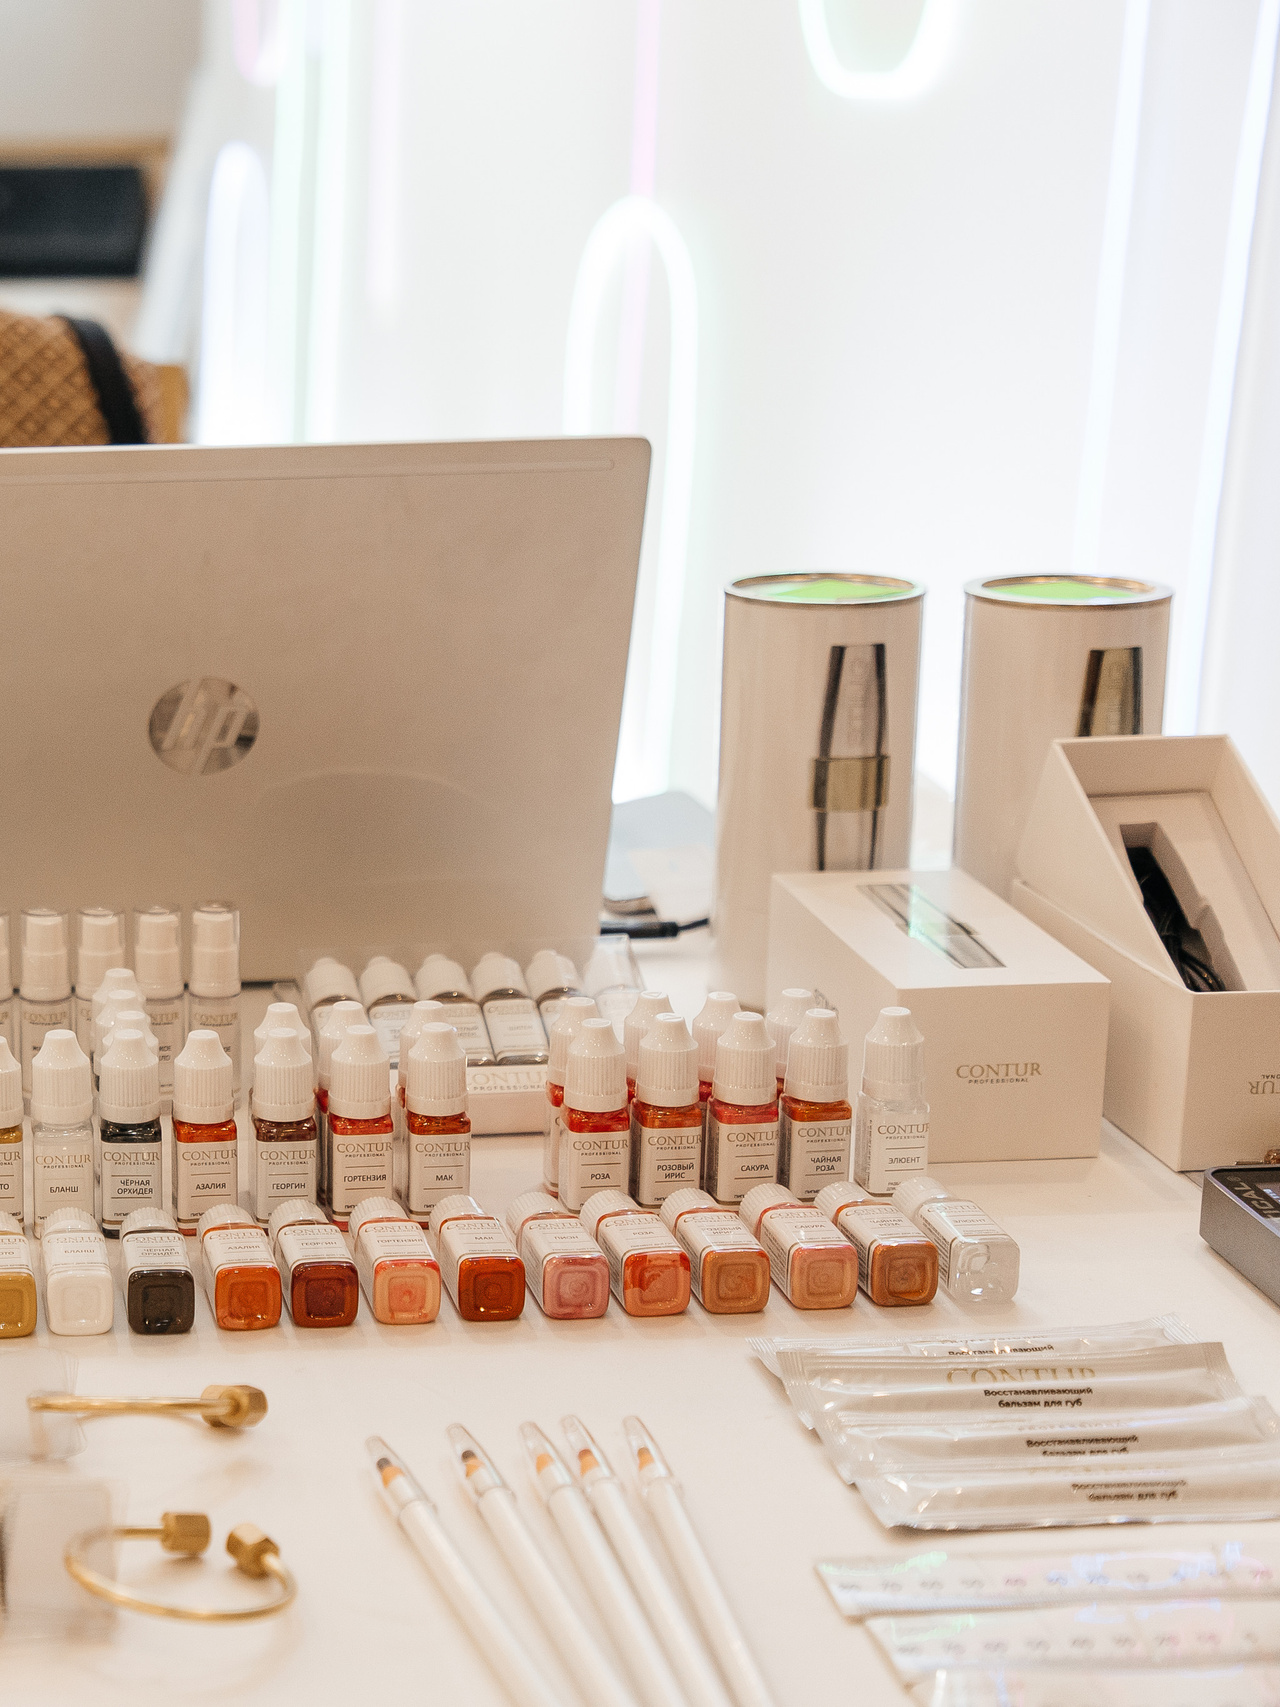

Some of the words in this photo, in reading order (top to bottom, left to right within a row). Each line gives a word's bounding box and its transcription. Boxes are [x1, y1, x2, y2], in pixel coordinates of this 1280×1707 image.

[956, 1062, 1042, 1079] CONTUR
[798, 1126, 851, 1138] CONTUR
[573, 1139, 628, 1150] CONTUR
[648, 1134, 702, 1146] CONTUR
[336, 1142, 392, 1153] CONTUR
[415, 1142, 470, 1153] CONTUR
[36, 1154, 92, 1165] CONTUR
[104, 1152, 160, 1162] CONTUR
[182, 1149, 238, 1161] CONTUR
[260, 1150, 316, 1160] CONTUR
[810, 1156, 842, 1164] ЧАЙНАЯ
[888, 1156, 920, 1164] ЭЛЮЕНТ
[657, 1162, 694, 1171] РОЗОВЫЙ
[740, 1164, 770, 1172] САКУРА
[816, 1164, 835, 1172] РОЗА
[120, 1178, 150, 1186] ЧЁРНАЯ
[344, 1174, 387, 1182] ГОРТЕНЗИЯ
[436, 1174, 454, 1182] МАК
[50, 1186, 79, 1194] БЛАНШ
[196, 1182, 226, 1190] АЗАЛИЯ
[116, 1188, 154, 1196] ОРХИДЕЯ
[983, 1387, 1093, 1397] Восстанавливающий
[998, 1400, 1040, 1408] бальзам
[1043, 1400, 1062, 1408] для
[1065, 1398, 1083, 1408] губ
